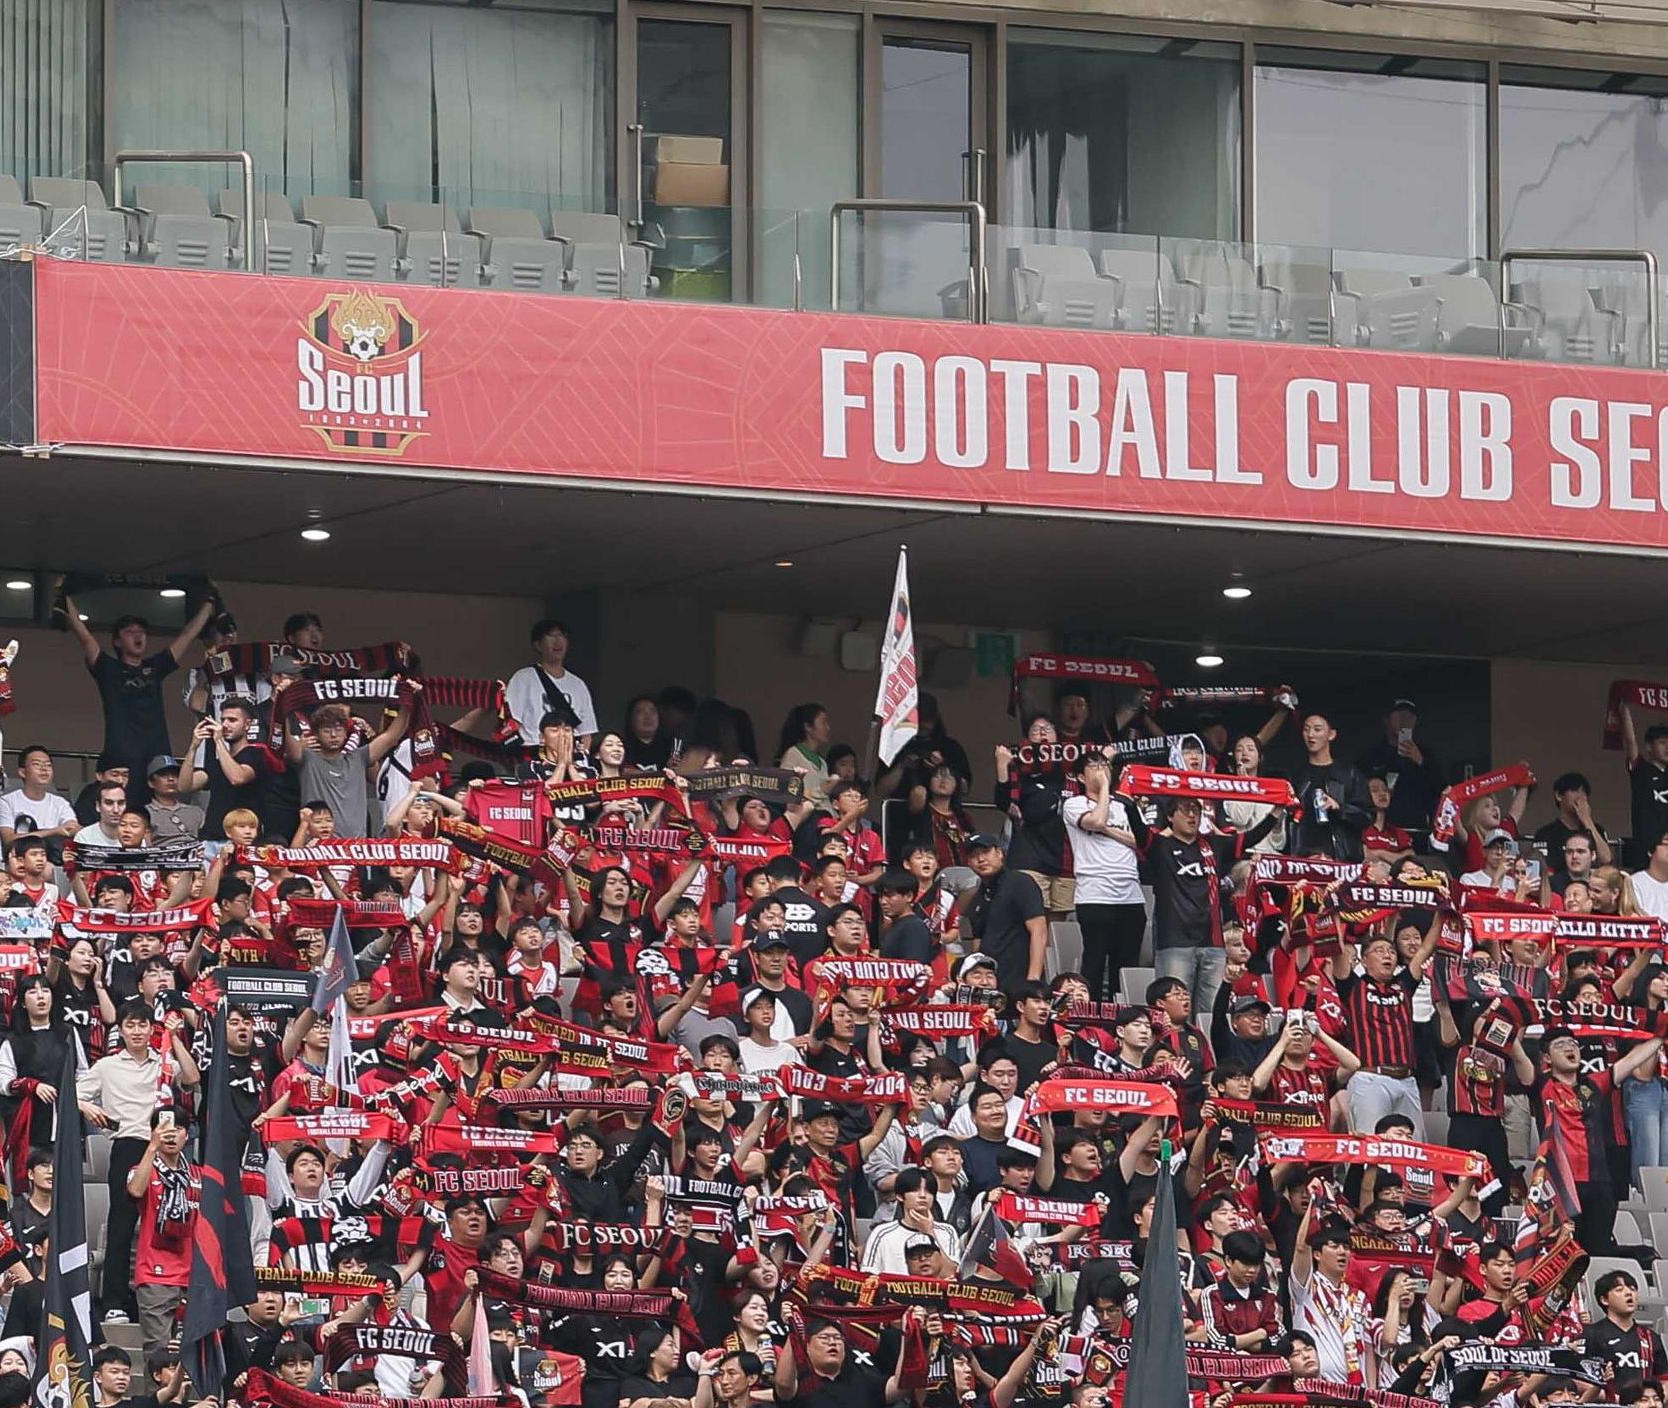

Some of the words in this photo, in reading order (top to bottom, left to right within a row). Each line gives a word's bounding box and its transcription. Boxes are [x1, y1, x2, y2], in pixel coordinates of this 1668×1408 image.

[355, 363, 373, 373] FC
[298, 337, 428, 420] Seoul
[821, 347, 1262, 484] FOOTBALL
[1286, 378, 1513, 500] CLUB
[1549, 396, 1668, 514] SE
[314, 680, 337, 698] FC
[341, 680, 399, 698] SEOUL
[490, 808, 503, 820] FC
[505, 808, 533, 821] SEOUL
[228, 981, 263, 994] FOOTBALL
[264, 982, 285, 994] CLUB
[287, 983, 307, 994] SEOUL
[919, 1014, 968, 1030] SEOUL
[1065, 1088, 1091, 1104] FC
[1096, 1090, 1151, 1106] SEOUL
[1336, 1139, 1359, 1155] FC
[1367, 1145, 1427, 1162] SEOUL
[887, 1281, 943, 1298] FOOTBALL
[948, 1285, 977, 1300] CLUB
[980, 1288, 1016, 1307] SEOUL
